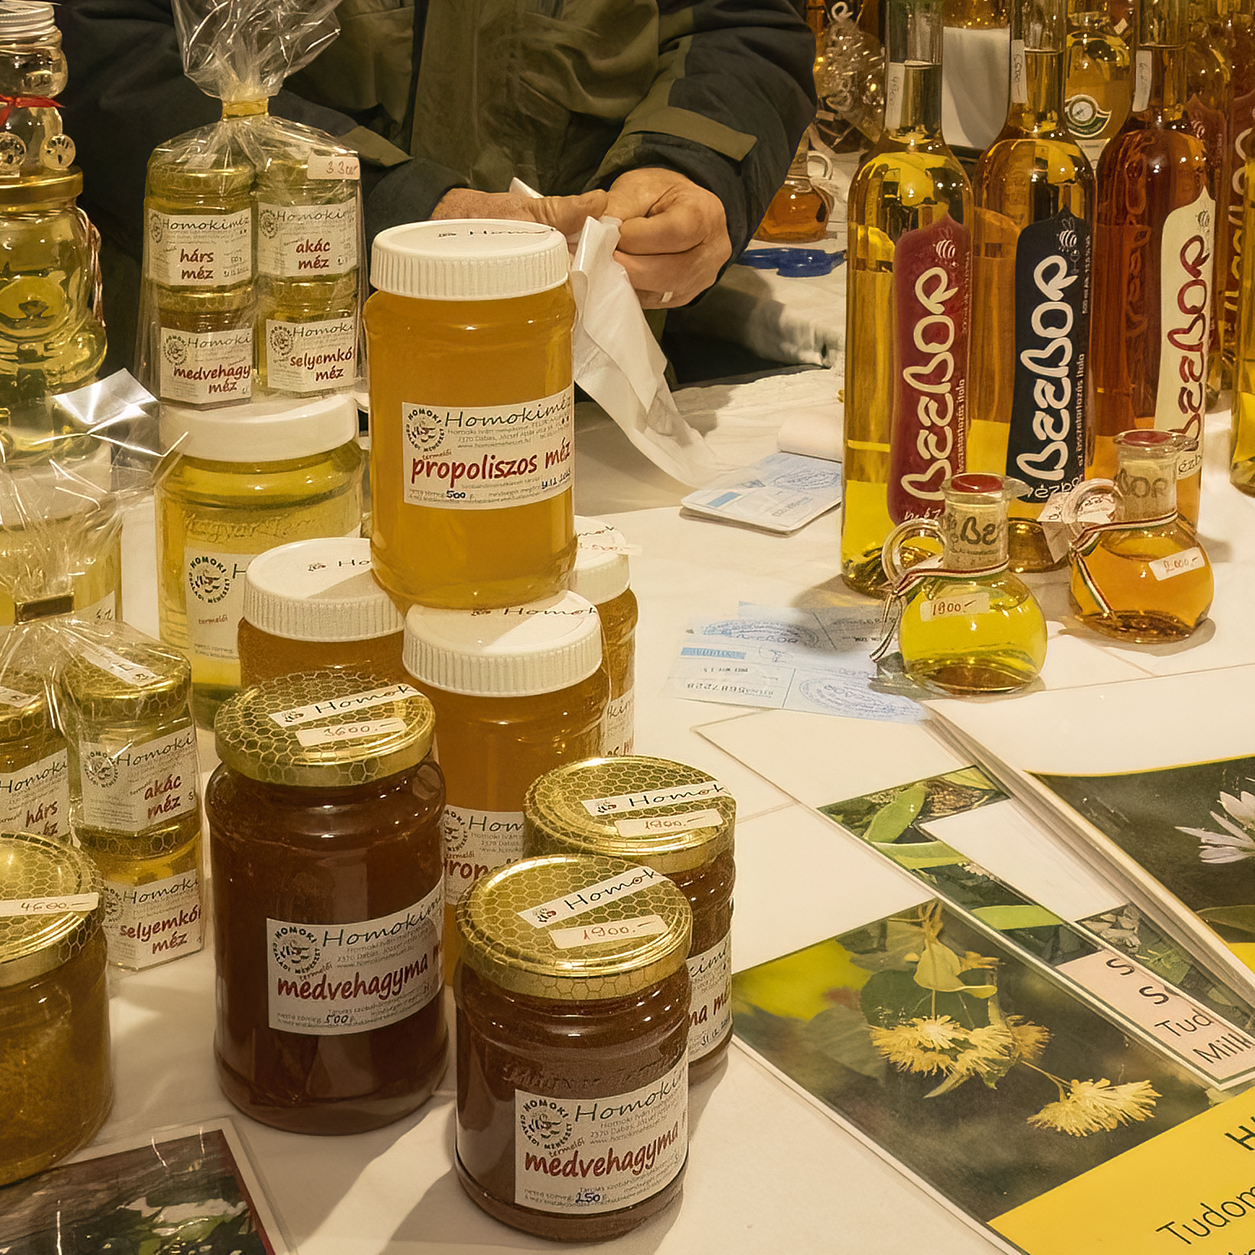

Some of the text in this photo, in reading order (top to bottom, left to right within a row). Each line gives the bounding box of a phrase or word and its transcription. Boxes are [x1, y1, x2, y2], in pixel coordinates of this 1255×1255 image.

[179, 248, 215, 265] hárs
[295, 238, 332, 255] akác
[181, 267, 215, 281] méz
[297, 256, 331, 271] méz
[314, 367, 346, 383] méz
[1015, 254, 1079, 481] BEEBOR
[208, 380, 239, 396] méz
[900, 266, 960, 502] BEEBOR
[407, 408, 442, 425] HOMOKI
[445, 393, 573, 429] Homokiméz
[410, 436, 572, 489] propoliszos méz
[188, 553, 228, 574] HOMOKI
[143, 773, 183, 801] akác
[25, 800, 59, 828] hárs
[147, 795, 182, 820] méz
[151, 931, 189, 954] méz
[274, 926, 318, 944] HOMOKI
[276, 952, 428, 1002] medvehagyma
[522, 1099, 570, 1119] HOMOKI
[524, 1120, 679, 1178] medvehagyma
[575, 1191, 601, 1204] 250
